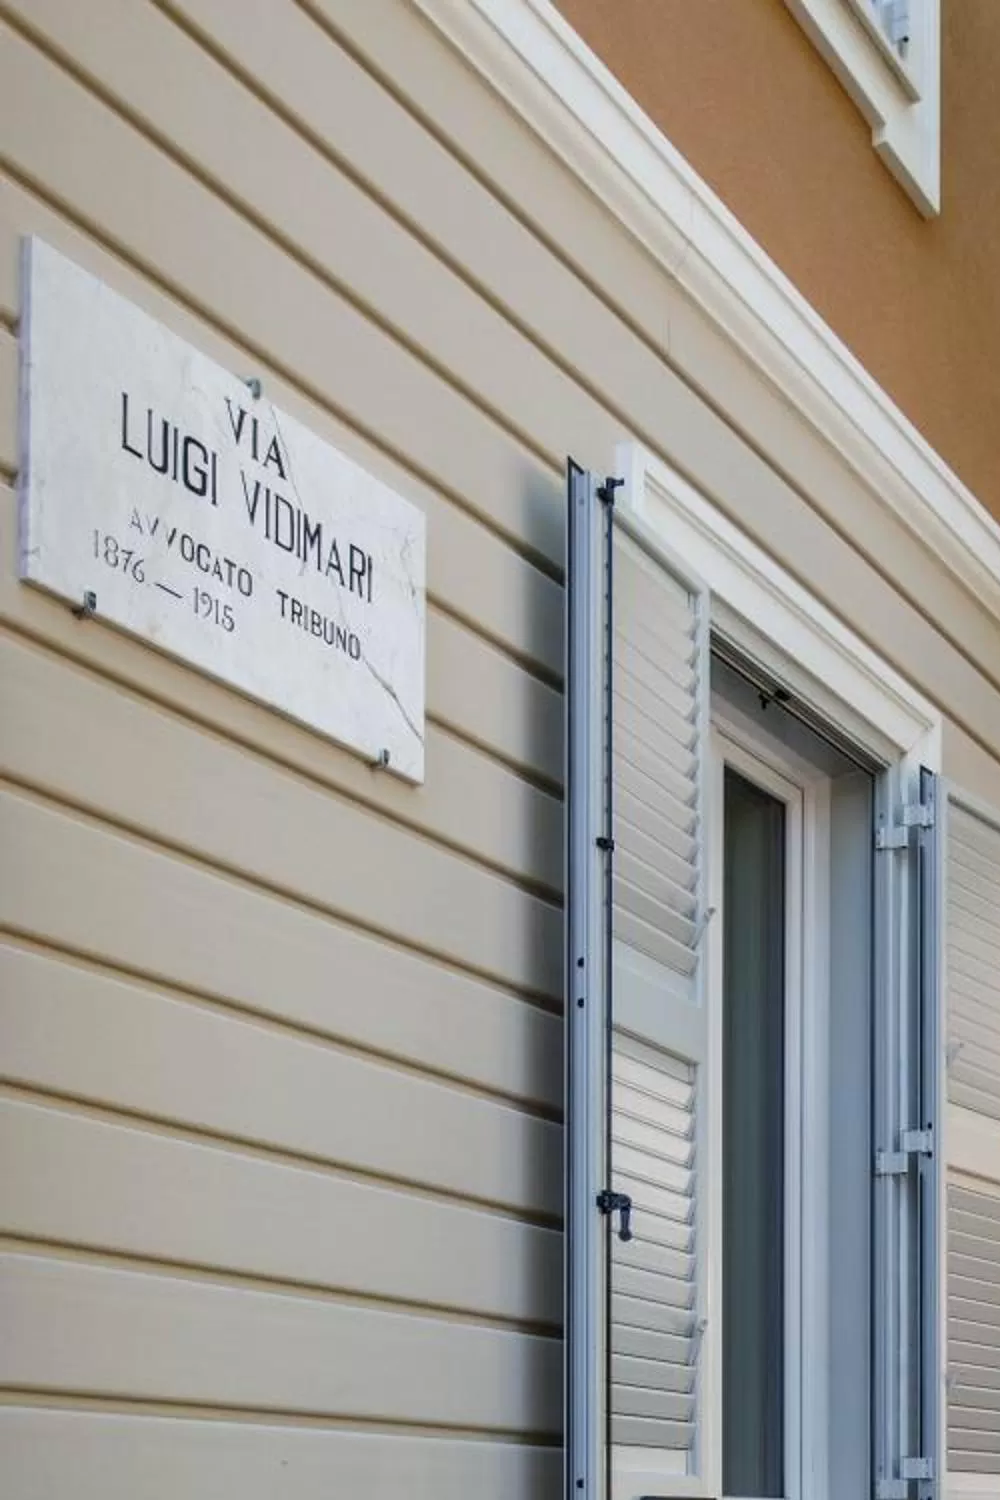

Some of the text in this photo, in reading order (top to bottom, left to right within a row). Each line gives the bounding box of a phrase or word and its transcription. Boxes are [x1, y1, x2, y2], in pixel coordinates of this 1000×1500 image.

[120, 392, 374, 603] LUIGI VIDIMARI
[225, 397, 288, 480] VIA
[93, 529, 146, 584] 1876
[193, 586, 236, 633] 1915
[128, 508, 362, 661] AVVOCATO TRIBUNO
